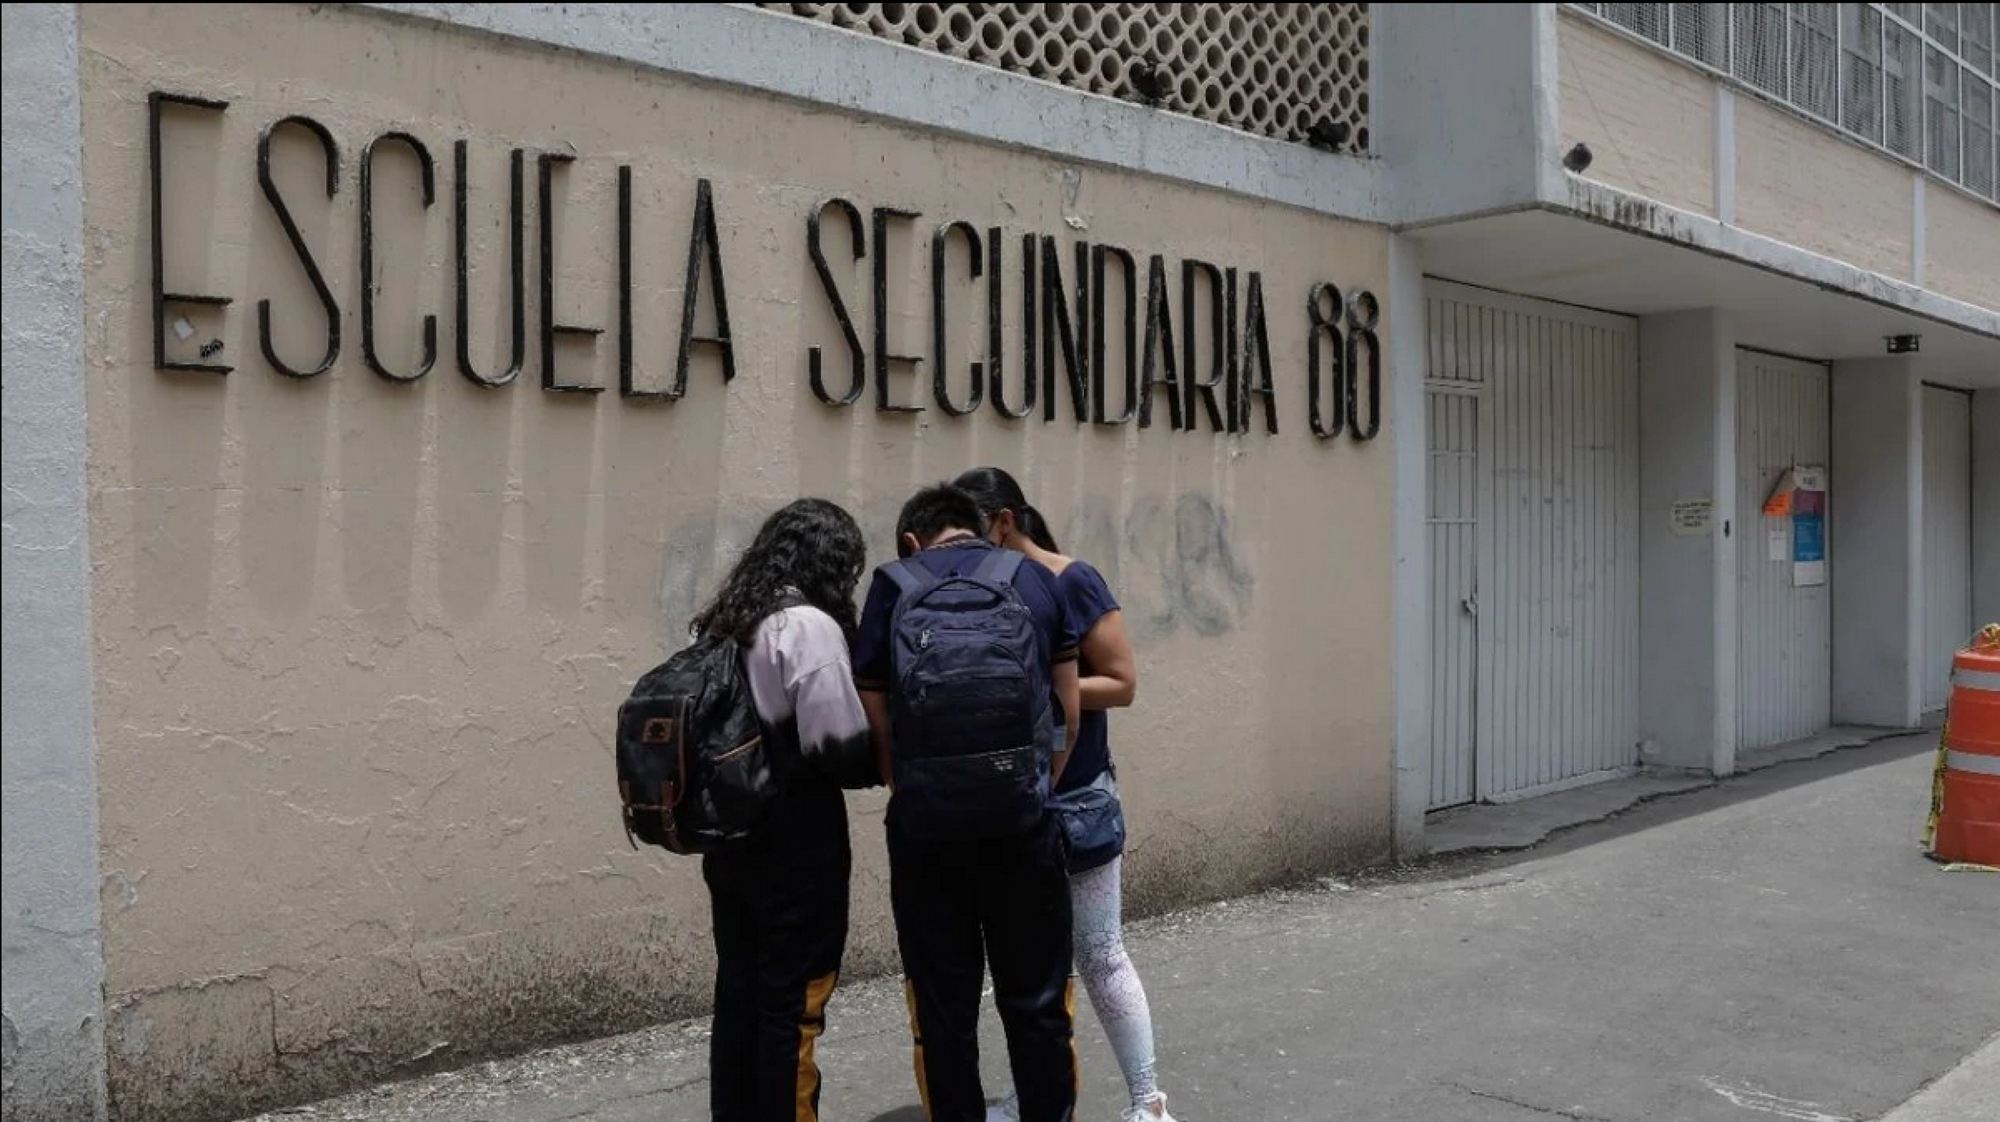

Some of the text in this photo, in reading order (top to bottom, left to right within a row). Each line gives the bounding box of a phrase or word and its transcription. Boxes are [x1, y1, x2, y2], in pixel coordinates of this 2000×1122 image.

[148, 91, 1380, 441] ESCUELA SECUNDARIA 88
